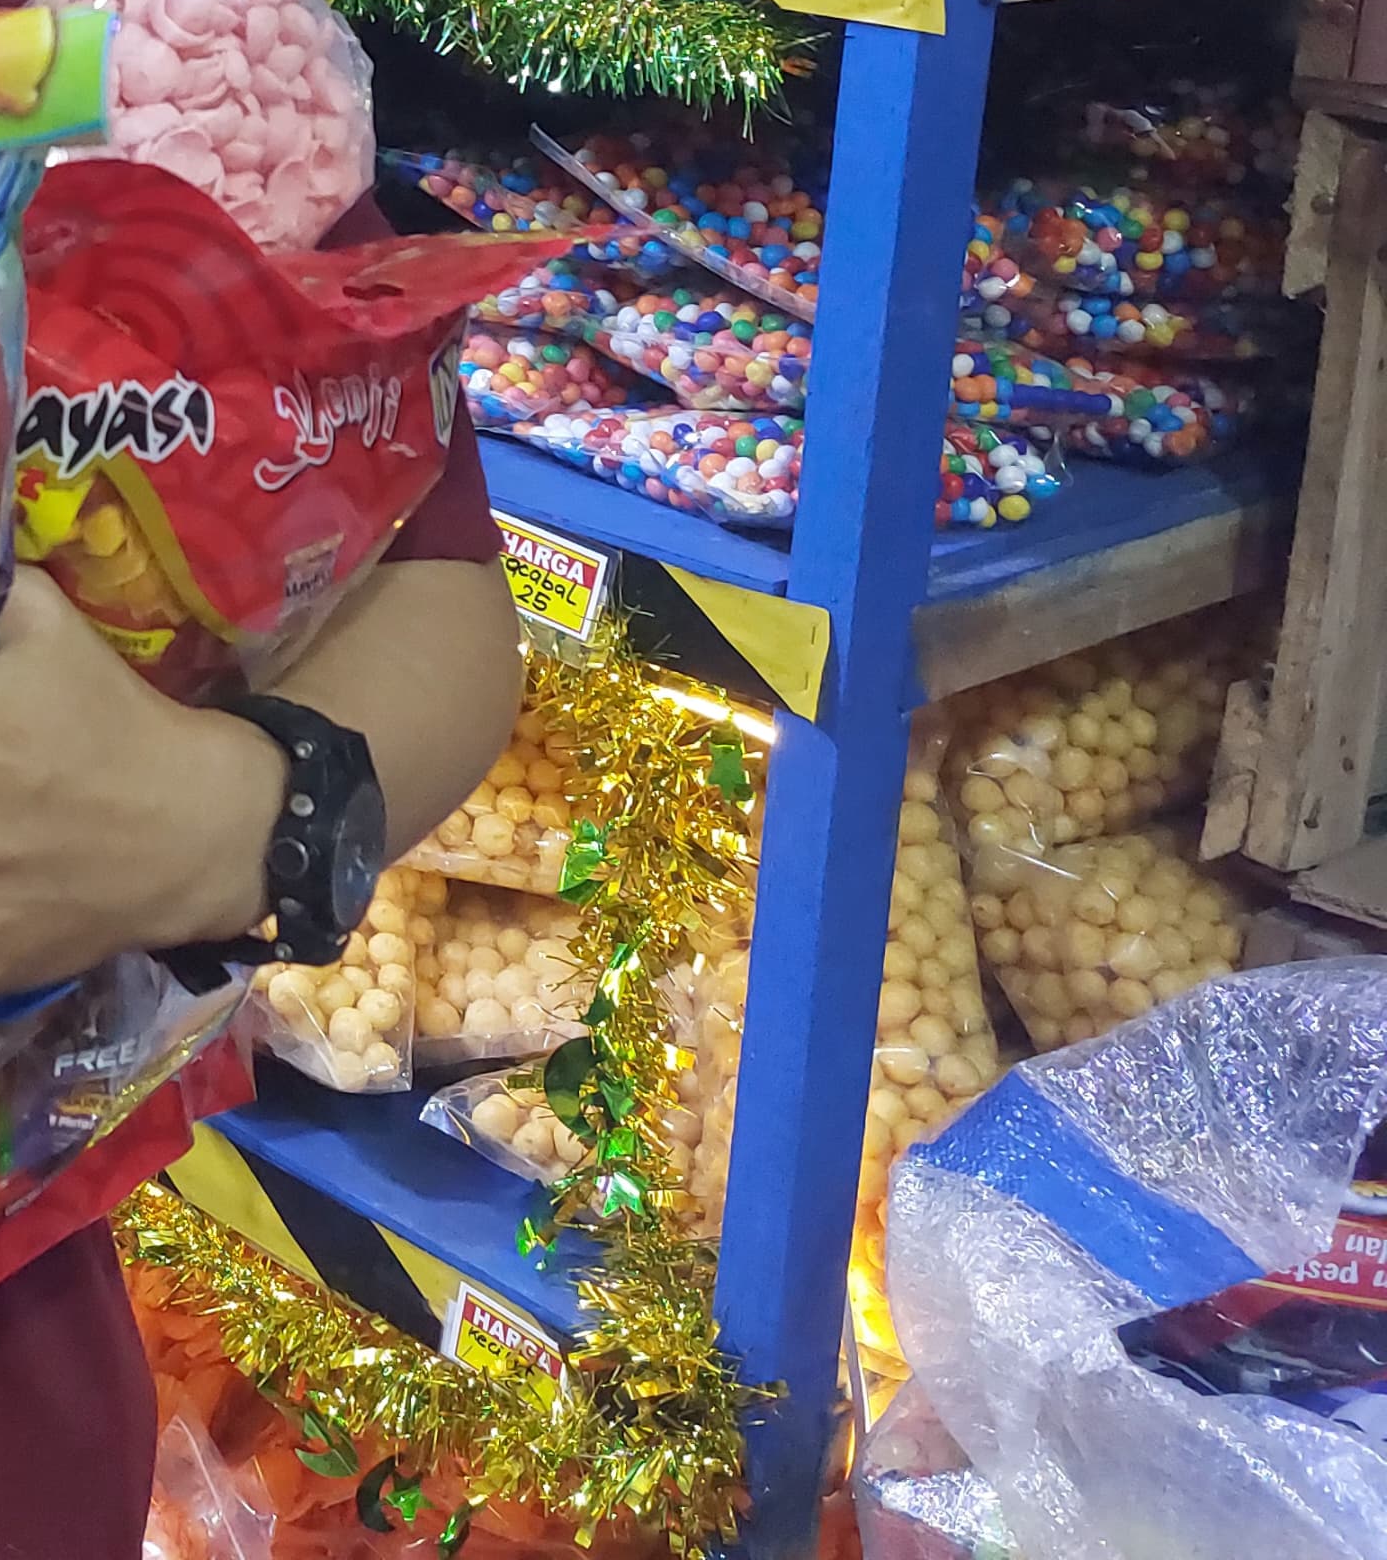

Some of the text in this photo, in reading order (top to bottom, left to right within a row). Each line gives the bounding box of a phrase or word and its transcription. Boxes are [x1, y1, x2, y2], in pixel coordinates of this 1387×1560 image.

[15, 380, 213, 478] ayasi
[502, 530, 584, 585] HARGA
[515, 584, 551, 612] 25
[53, 1038, 139, 1078] FREE
[1280, 1258, 1359, 1285] pest
